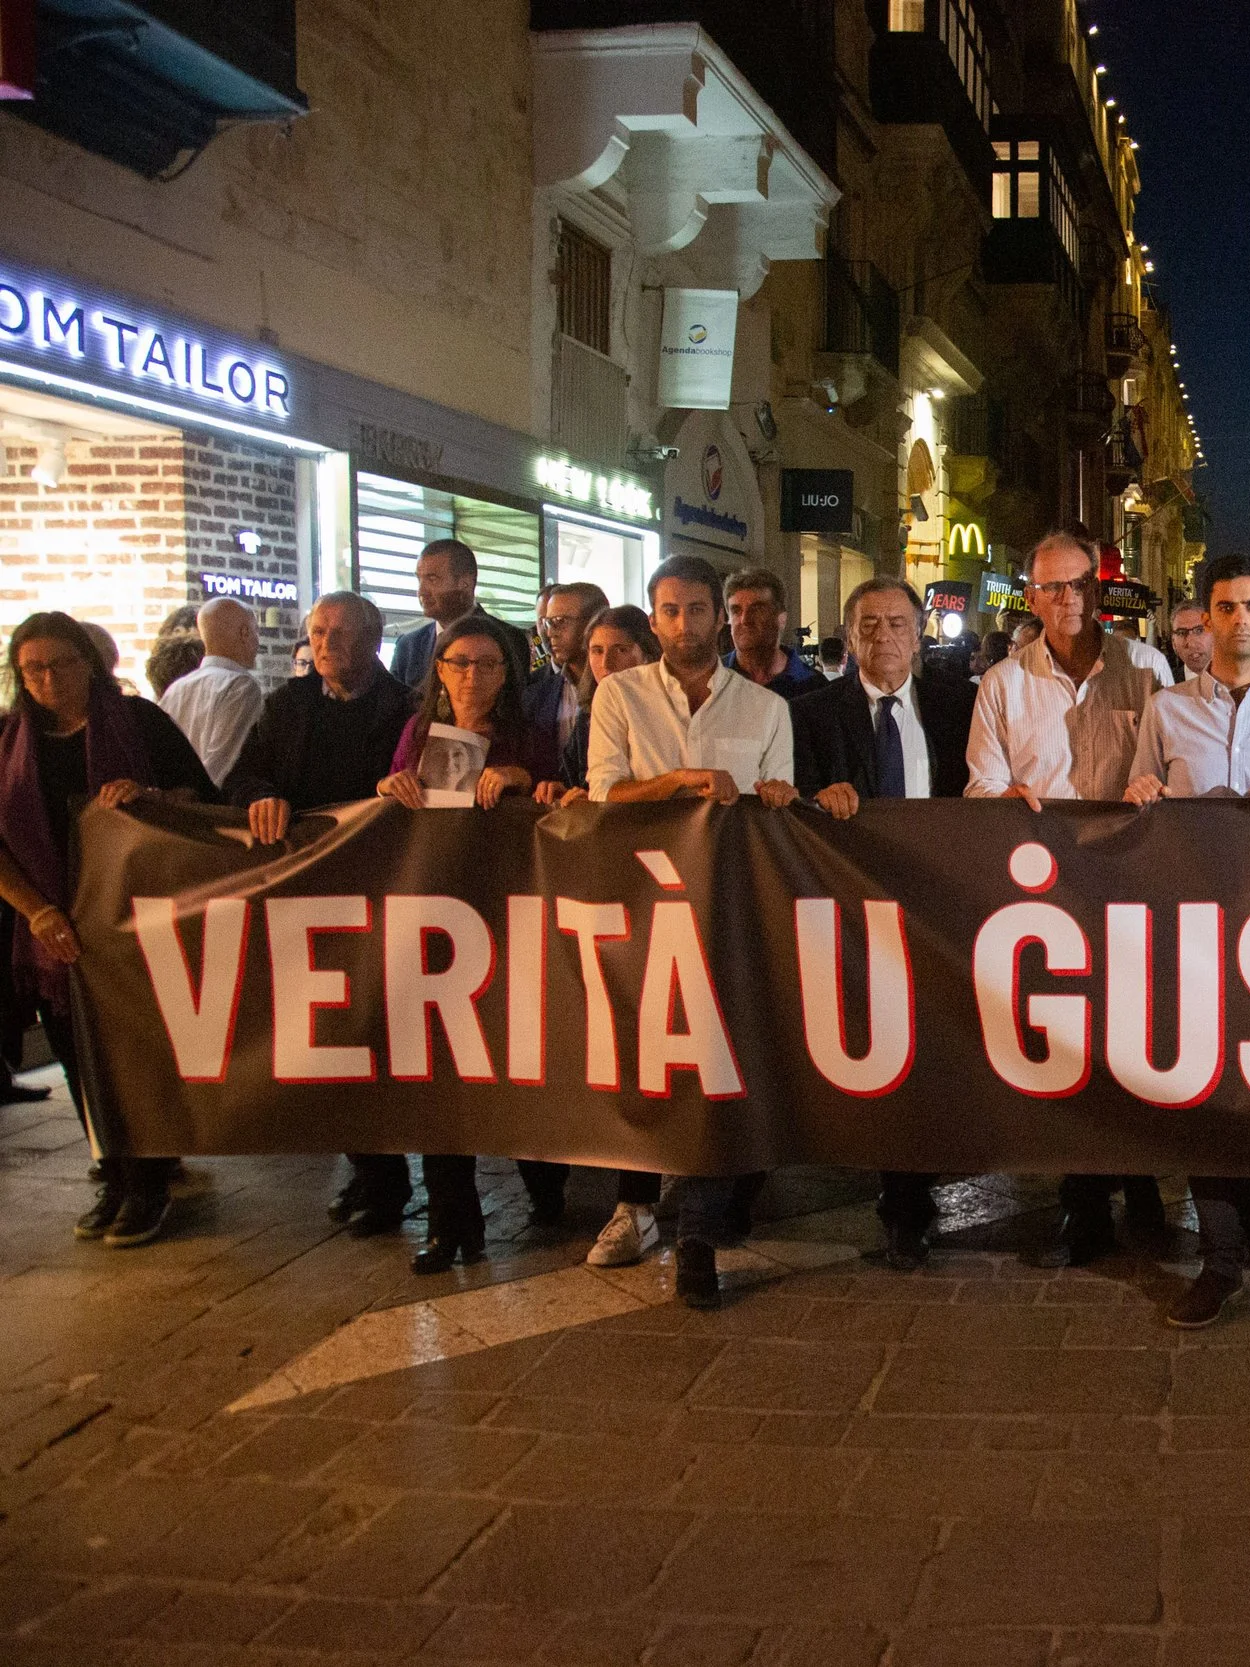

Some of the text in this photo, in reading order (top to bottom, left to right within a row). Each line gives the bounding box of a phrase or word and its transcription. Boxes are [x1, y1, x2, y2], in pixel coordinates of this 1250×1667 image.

[102, 316, 290, 414] TAILOR
[536, 457, 592, 501] NEW
[203, 574, 297, 600] TOM TAILOR
[986, 580, 1023, 597] TRUTH AND
[986, 592, 1031, 612] JUSTICE
[132, 850, 746, 1101] VERITÀ
[794, 897, 917, 1100] U
